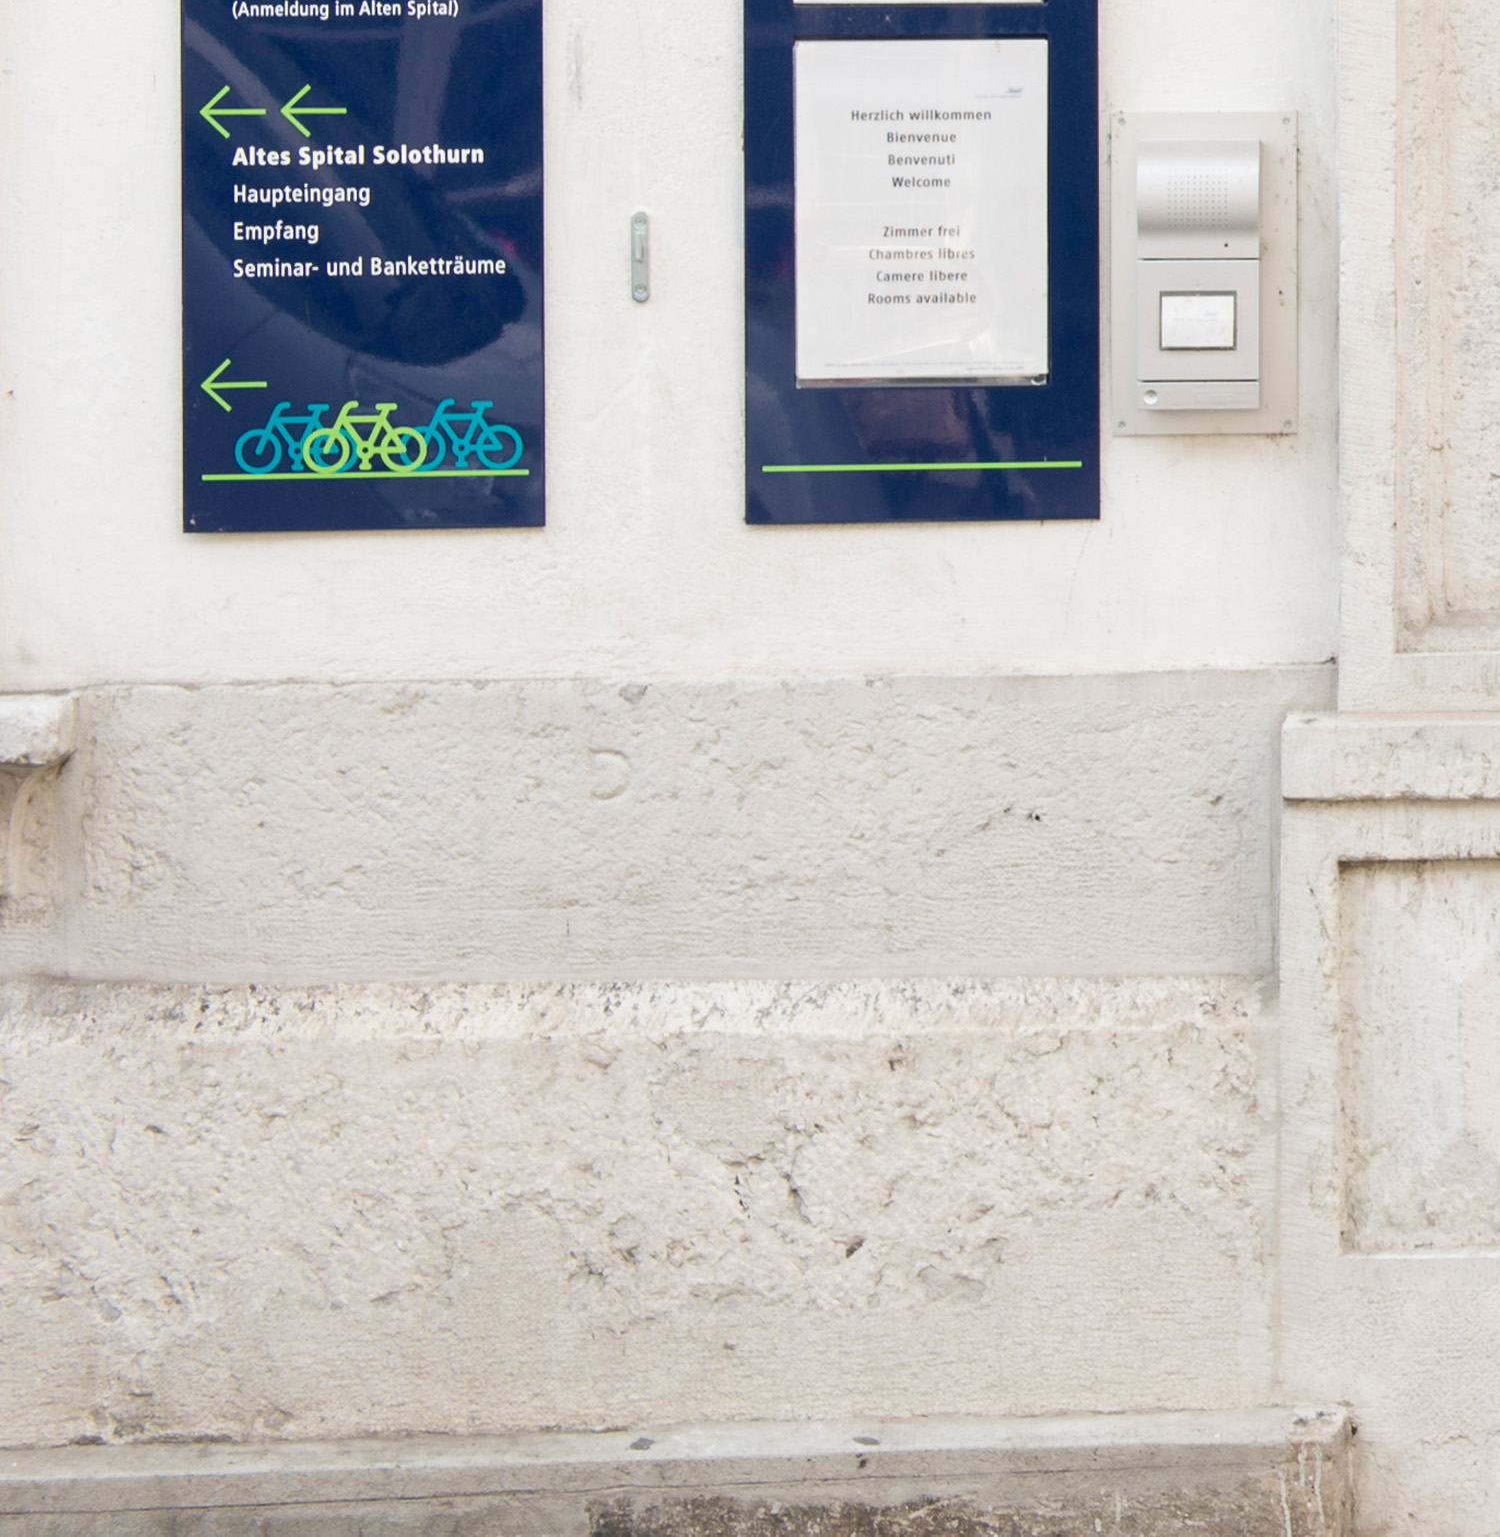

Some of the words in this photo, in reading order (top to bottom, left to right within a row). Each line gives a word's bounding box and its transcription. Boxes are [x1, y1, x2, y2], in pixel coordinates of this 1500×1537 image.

[231, 0, 330, 19] (Anmeldung
[335, 0, 355, 17] im
[358, 0, 402, 17] Alten
[407, 0, 459, 19] Spital)
[851, 109, 904, 121] Herzlich
[908, 109, 992, 121] willkommen
[886, 131, 957, 143] Bienvenue
[231, 146, 291, 166] Altes
[298, 145, 365, 170] Spital
[372, 144, 485, 165] Solothurn
[887, 154, 956, 166] Benvenuti
[891, 176, 951, 188] Welcome
[233, 184, 371, 207] Haupteingang
[233, 220, 319, 244] Empfang
[883, 225, 933, 238] Zimmer
[937, 225, 960, 238] frei
[868, 248, 934, 260] Chambres
[938, 247, 975, 260] libres
[233, 258, 319, 278] Seminar-
[326, 256, 363, 277] und
[370, 255, 506, 276] Banketträume
[876, 270, 925, 282] Camere
[929, 270, 968, 282] libere
[867, 292, 911, 305] Rooms
[915, 292, 977, 305] available
